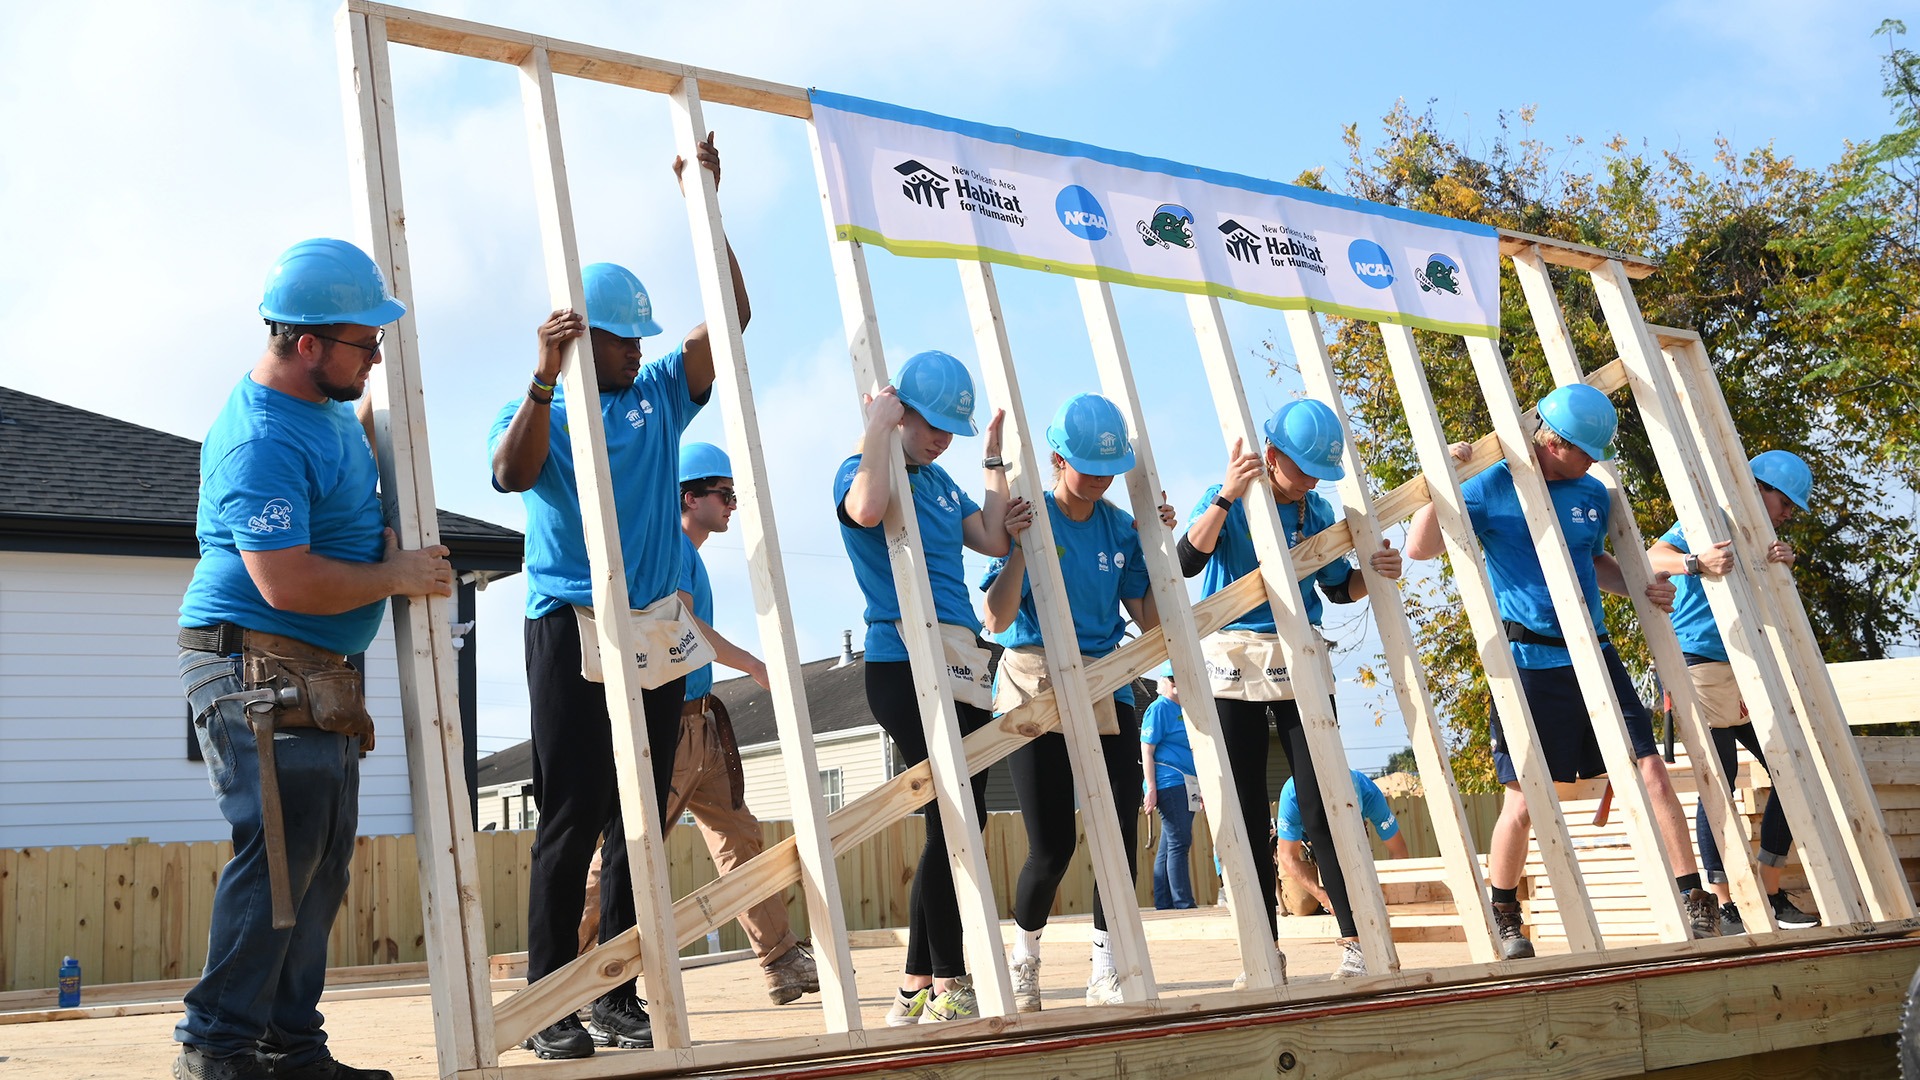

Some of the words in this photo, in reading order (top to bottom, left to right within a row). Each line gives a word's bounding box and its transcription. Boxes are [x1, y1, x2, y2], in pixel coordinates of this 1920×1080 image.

[952, 166, 969, 176] New
[971, 170, 997, 186] Orleans
[999, 180, 1016, 191] Area
[955, 179, 1022, 213] Habitat
[960, 200, 976, 212] for
[1064, 211, 1108, 231] NCAA
[1262, 224, 1278, 234] New
[1279, 226, 1303, 239] Orleans
[1303, 232, 1318, 243] Area
[1265, 237, 1323, 263] Habitat
[1271, 257, 1285, 267] for
[1355, 262, 1395, 278] NCAA
[1215, 667, 1241, 676] Hatat
